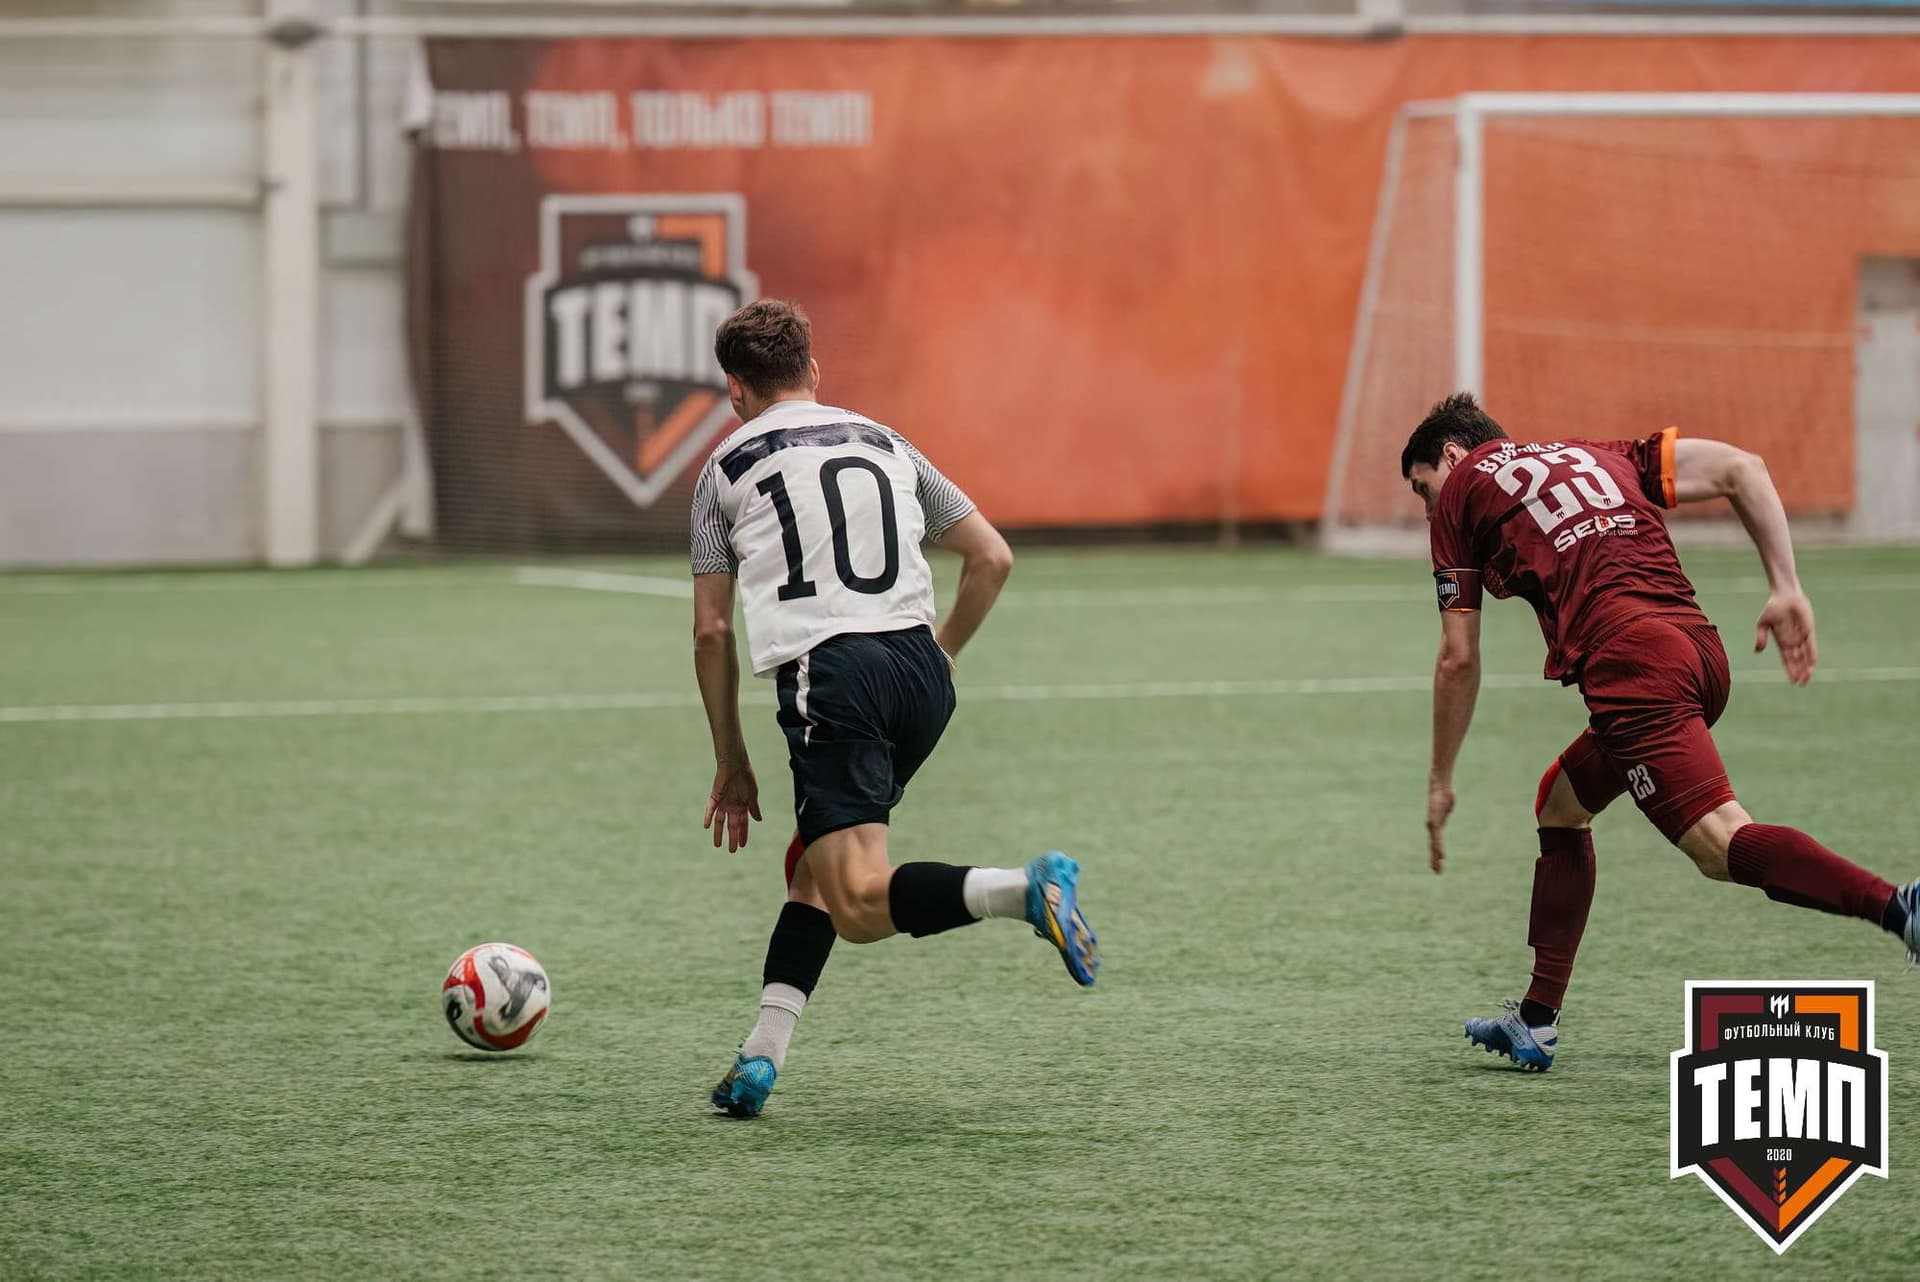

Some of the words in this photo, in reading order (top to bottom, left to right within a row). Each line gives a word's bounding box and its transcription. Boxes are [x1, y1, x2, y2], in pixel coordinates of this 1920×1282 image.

[430, 91, 520, 153] ЕМП,
[756, 456, 899, 601] 10
[1494, 447, 1626, 535] 23
[1627, 763, 1656, 800] 23
